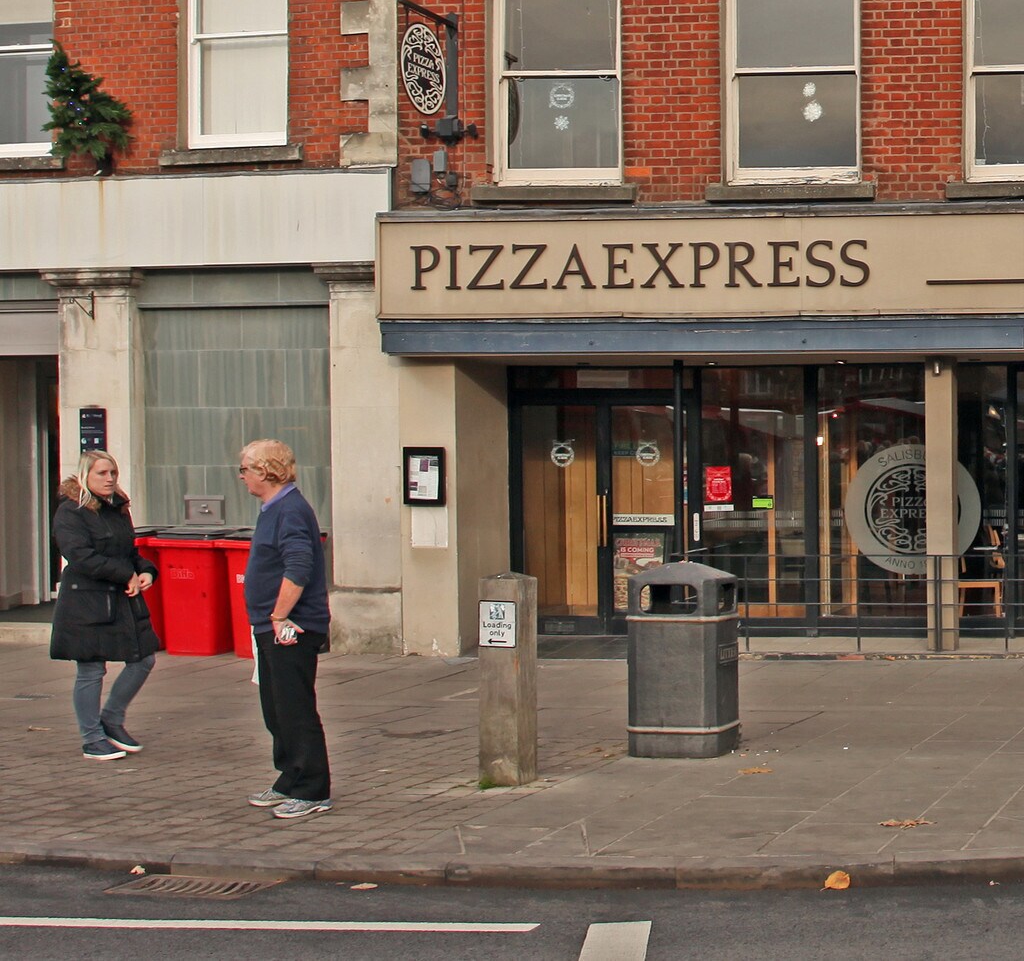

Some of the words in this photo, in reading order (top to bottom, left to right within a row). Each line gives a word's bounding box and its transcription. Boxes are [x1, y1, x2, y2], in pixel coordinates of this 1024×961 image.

[412, 52, 435, 70] PIZZA
[407, 61, 440, 84] EXPRESS
[410, 239, 870, 290] PIZZAEXPRESS
[877, 449, 926, 467] SALISB
[892, 496, 926, 507] PIZZ
[880, 508, 926, 519] EXPRE
[482, 621, 512, 629] Loading
